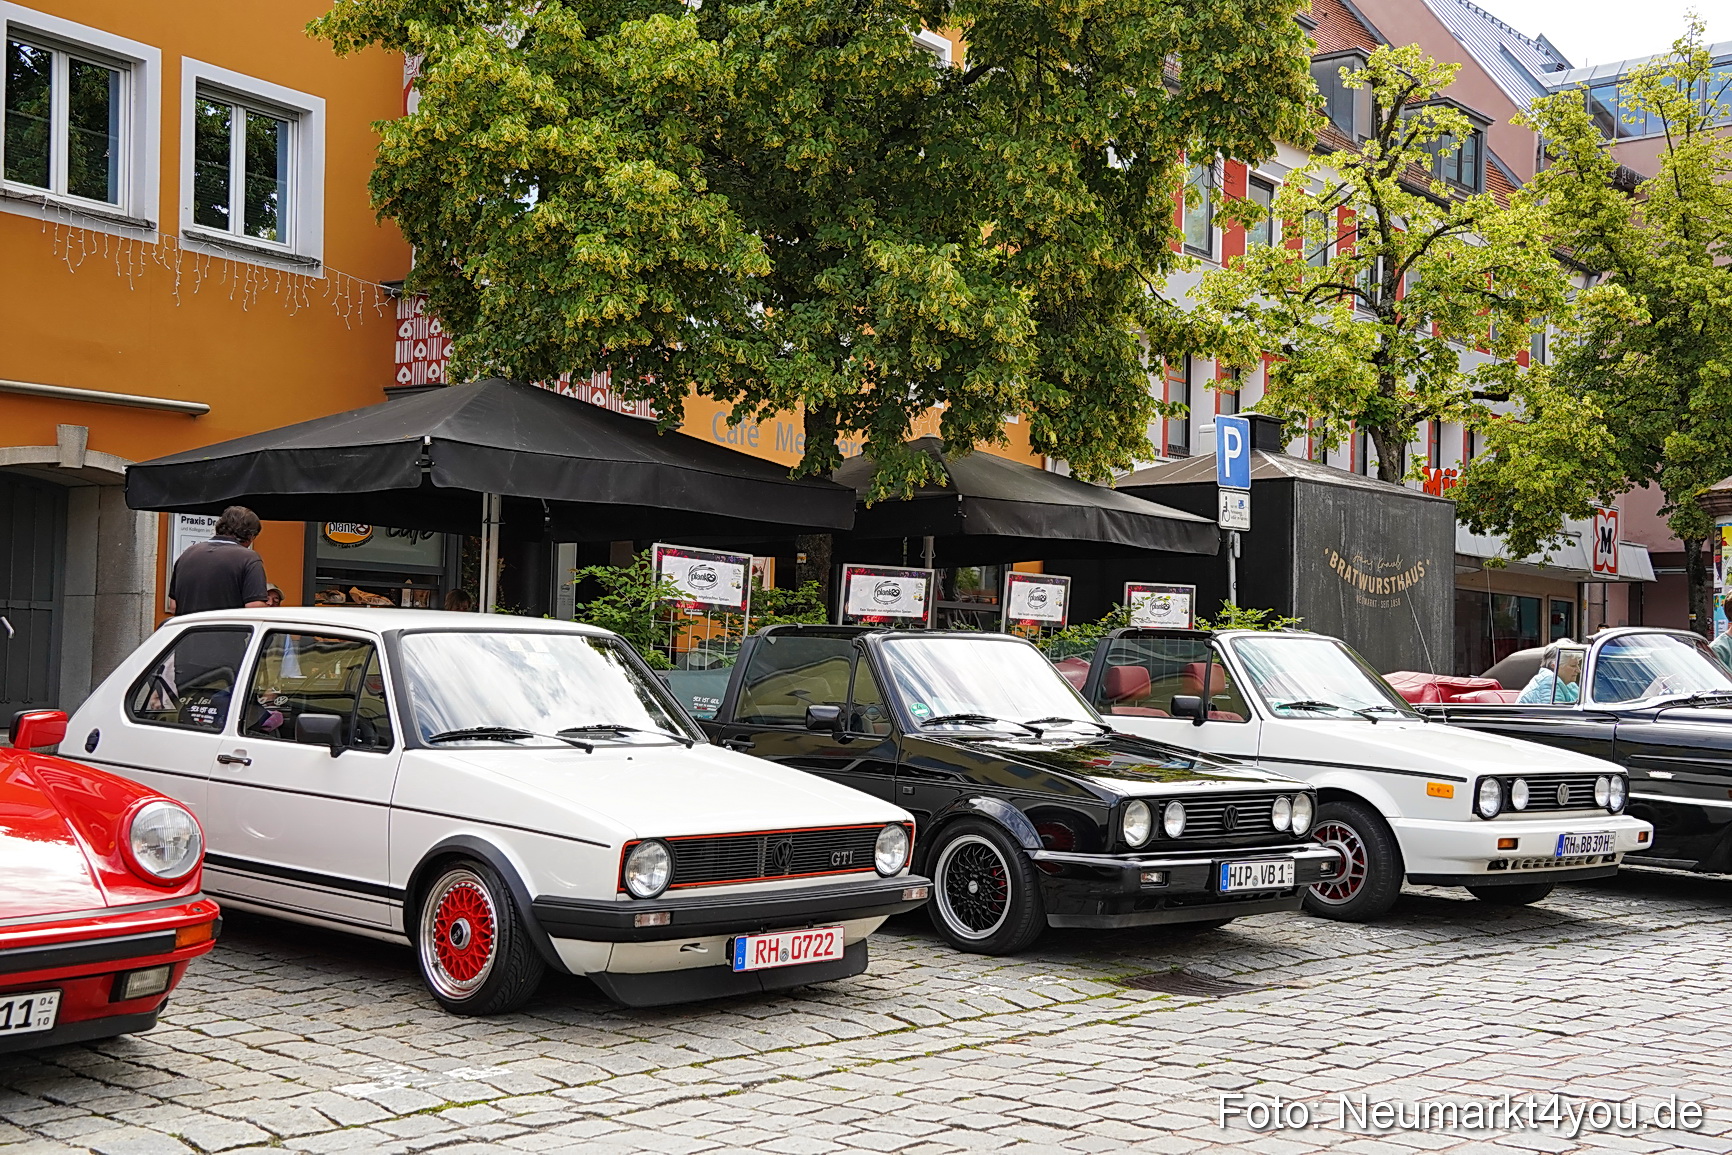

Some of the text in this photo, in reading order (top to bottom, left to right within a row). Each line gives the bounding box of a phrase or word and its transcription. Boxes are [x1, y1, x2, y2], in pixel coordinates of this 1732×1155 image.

[712, 411, 759, 447] Café
[1223, 426, 1242, 478] P
[180, 515, 206, 526] Praxis
[1563, 836, 1577, 854] RH
[1580, 835, 1592, 853] BB
[1592, 834, 1610, 852] 39H
[830, 850, 854, 866] GTI
[1228, 865, 1253, 887] HIP
[1260, 864, 1276, 885] VB
[1277, 864, 1286, 884] 1
[755, 938, 780, 965] RH
[791, 932, 835, 960] 0722
[39, 996, 54, 1006] 04
[37, 1016, 50, 1026] 10
